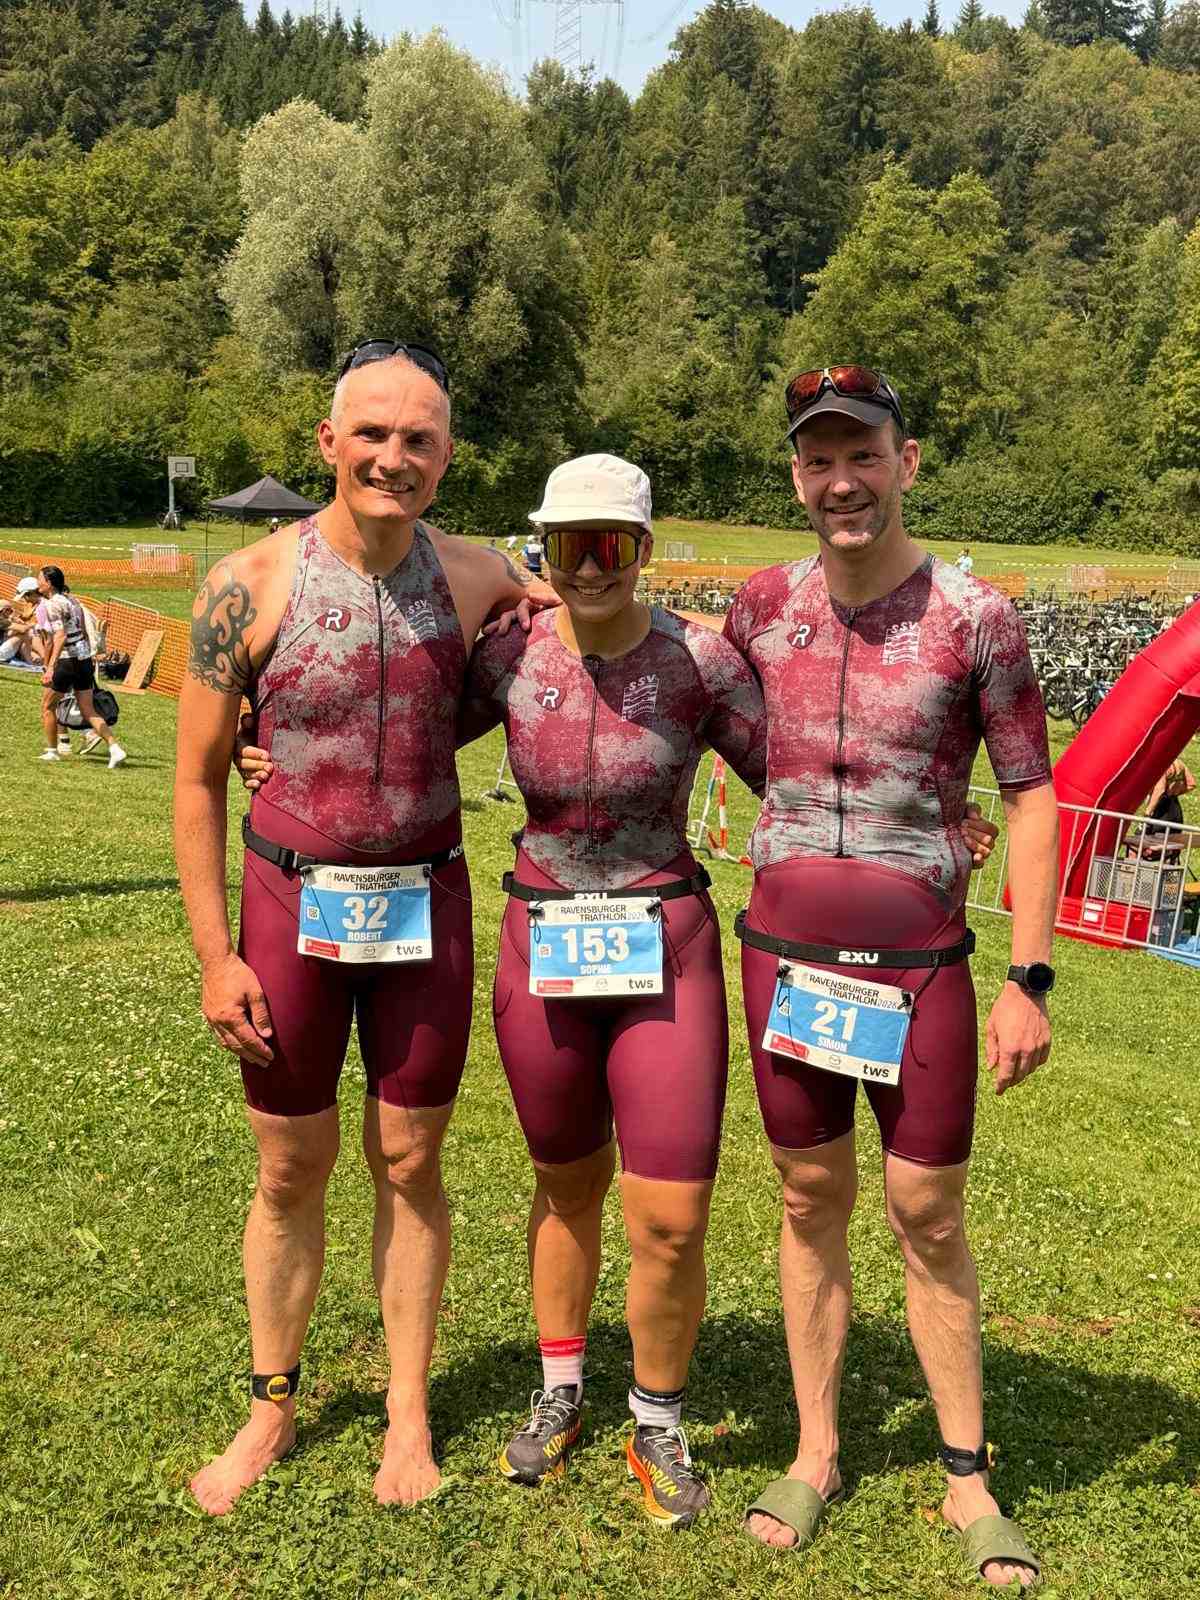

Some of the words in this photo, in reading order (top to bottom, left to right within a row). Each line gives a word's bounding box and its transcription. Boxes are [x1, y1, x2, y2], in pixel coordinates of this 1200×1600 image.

[408, 599, 428, 614] SSV
[325, 608, 343, 629] R
[891, 620, 919, 634] SSV
[791, 624, 811, 646] R
[628, 673, 657, 691] SSV
[542, 687, 560, 708] R
[334, 872, 401, 883] RAVENSBURGER
[343, 896, 389, 929] 32
[560, 904, 627, 914] RAVENSBURGER
[347, 931, 383, 942] ROBERT
[396, 944, 424, 955] tws
[562, 927, 629, 963] 153
[838, 951, 879, 963] 2XU
[629, 979, 654, 990] tws
[809, 974, 880, 998] RAVENSBURGER
[811, 1001, 857, 1041] 21
[817, 1037, 849, 1052] SIMON
[863, 1063, 890, 1078] tws
